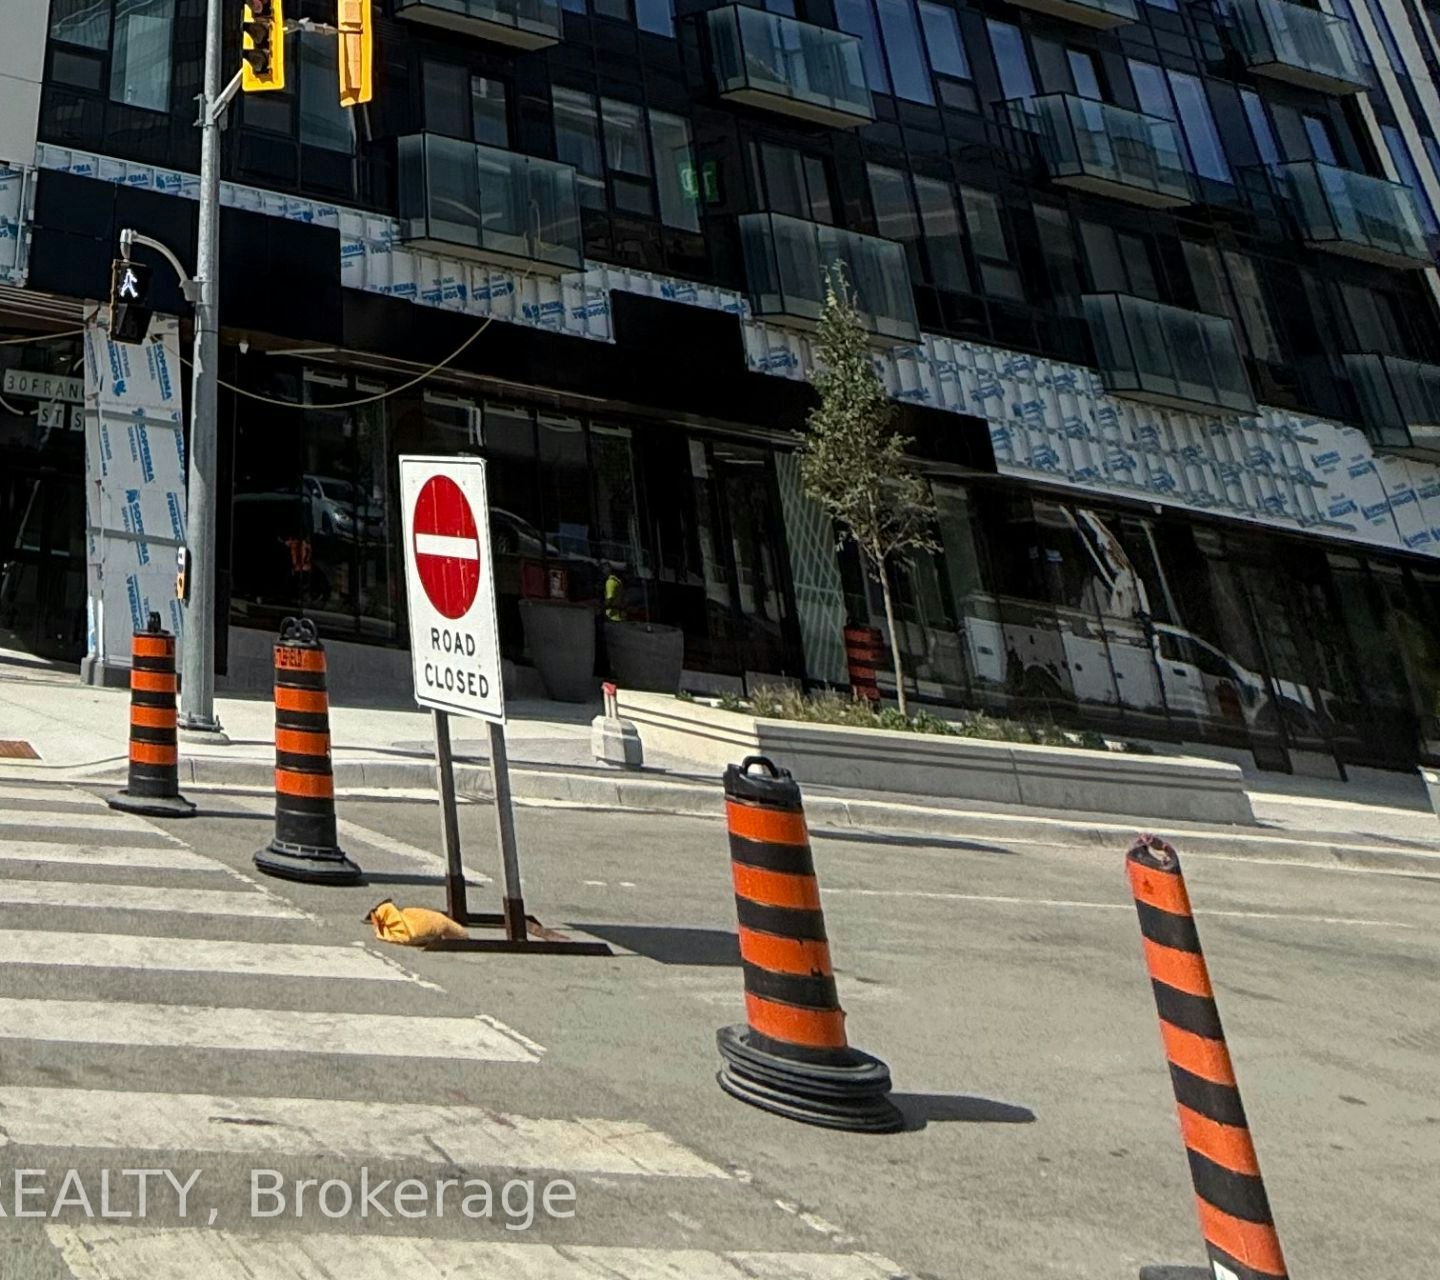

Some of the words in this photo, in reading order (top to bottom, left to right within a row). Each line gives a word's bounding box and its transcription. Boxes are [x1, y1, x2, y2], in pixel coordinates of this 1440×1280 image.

[157, 343, 172, 400] SOPREMA
[431, 627, 475, 656] ROAD
[425, 663, 488, 698] CLOSED
